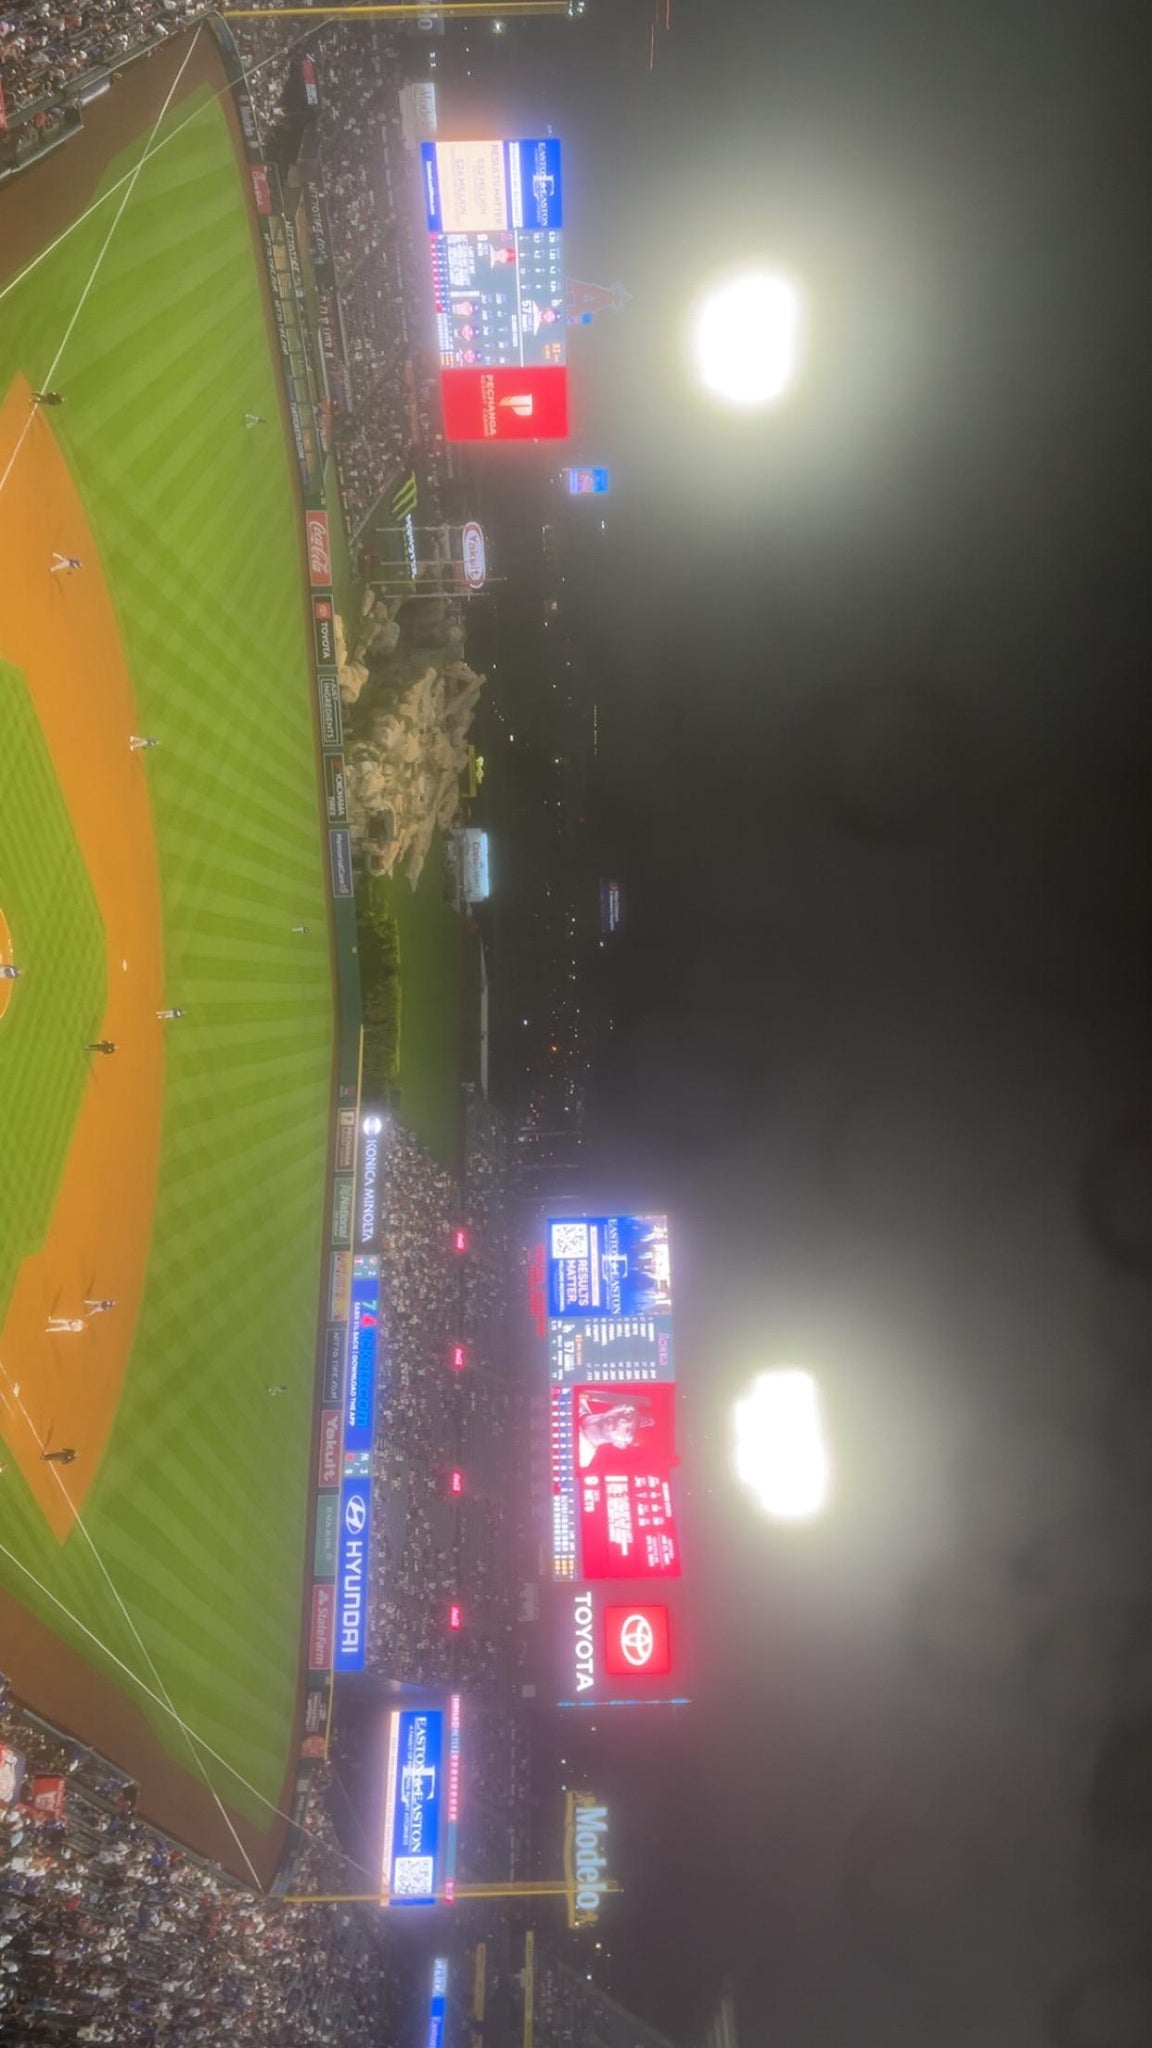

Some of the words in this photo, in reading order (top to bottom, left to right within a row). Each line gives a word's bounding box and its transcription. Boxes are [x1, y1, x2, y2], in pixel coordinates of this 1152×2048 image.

[522, 300, 532, 314] 57
[485, 374, 497, 436] PECHANGA
[468, 534, 480, 578] Yakult
[320, 622, 331, 659] TOYOTA
[323, 683, 335, 739] INGREDIENTS
[328, 796, 336, 816] TIRES
[335, 773, 346, 816] YOKOHAMA
[335, 833, 347, 885] MemorialCare
[344, 1127, 352, 1166] PECHANGA
[363, 1140, 377, 1187] KONICA
[338, 1197, 350, 1239] National
[361, 1187, 374, 1243] MINOLTA
[565, 1260, 577, 1305] MATTER.
[577, 1260, 589, 1306] RESULTS
[351, 1331, 359, 1350] BACK
[349, 1354, 358, 1397] DOWNLOAD
[348, 1397, 356, 1411] THE
[348, 1411, 356, 1426] APP
[323, 1416, 339, 1482] Yakult
[341, 1541, 363, 1653] HYUNDAI
[574, 1591, 594, 1692] TOYOTA
[413, 1717, 427, 1773] EASTON
[411, 1792, 423, 1853] EASTON
[575, 1806, 609, 1909] Modelo
